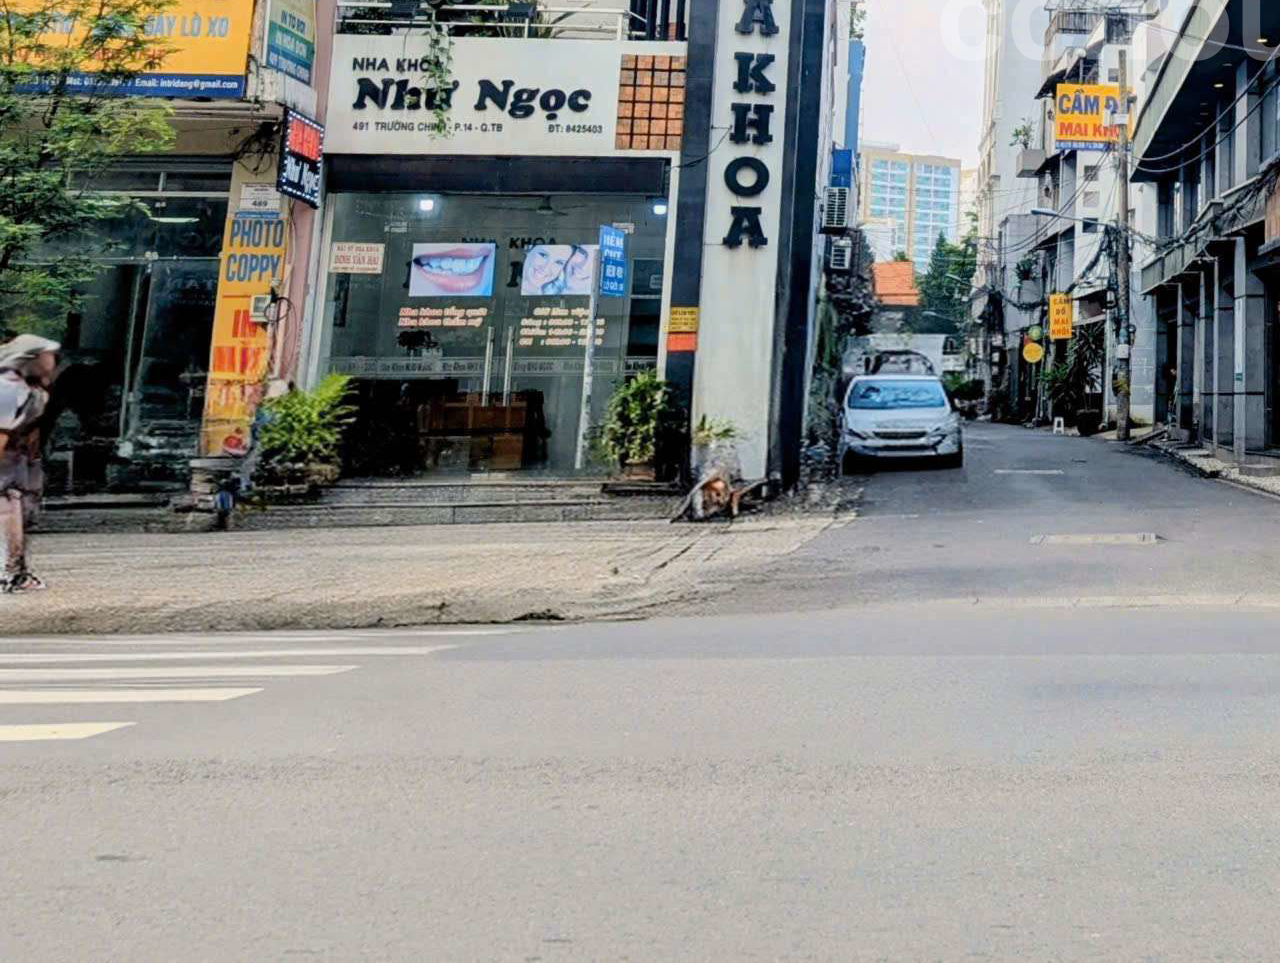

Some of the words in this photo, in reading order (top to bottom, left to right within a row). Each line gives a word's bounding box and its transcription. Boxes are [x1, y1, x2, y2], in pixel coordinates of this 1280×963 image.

[180, 12, 203, 37] LÒ
[207, 17, 230, 37] XO
[353, 57, 389, 72] NHA
[353, 77, 460, 111] Như
[474, 80, 592, 121] Ngọc
[1058, 88, 1100, 115] CẦM
[353, 122, 369, 132] 491
[1059, 122, 1088, 137] MAI
[1093, 123, 1119, 138] KH
[723, 52, 776, 248] KHOA
[229, 219, 285, 248] PHOTO
[226, 253, 281, 283] COPPY
